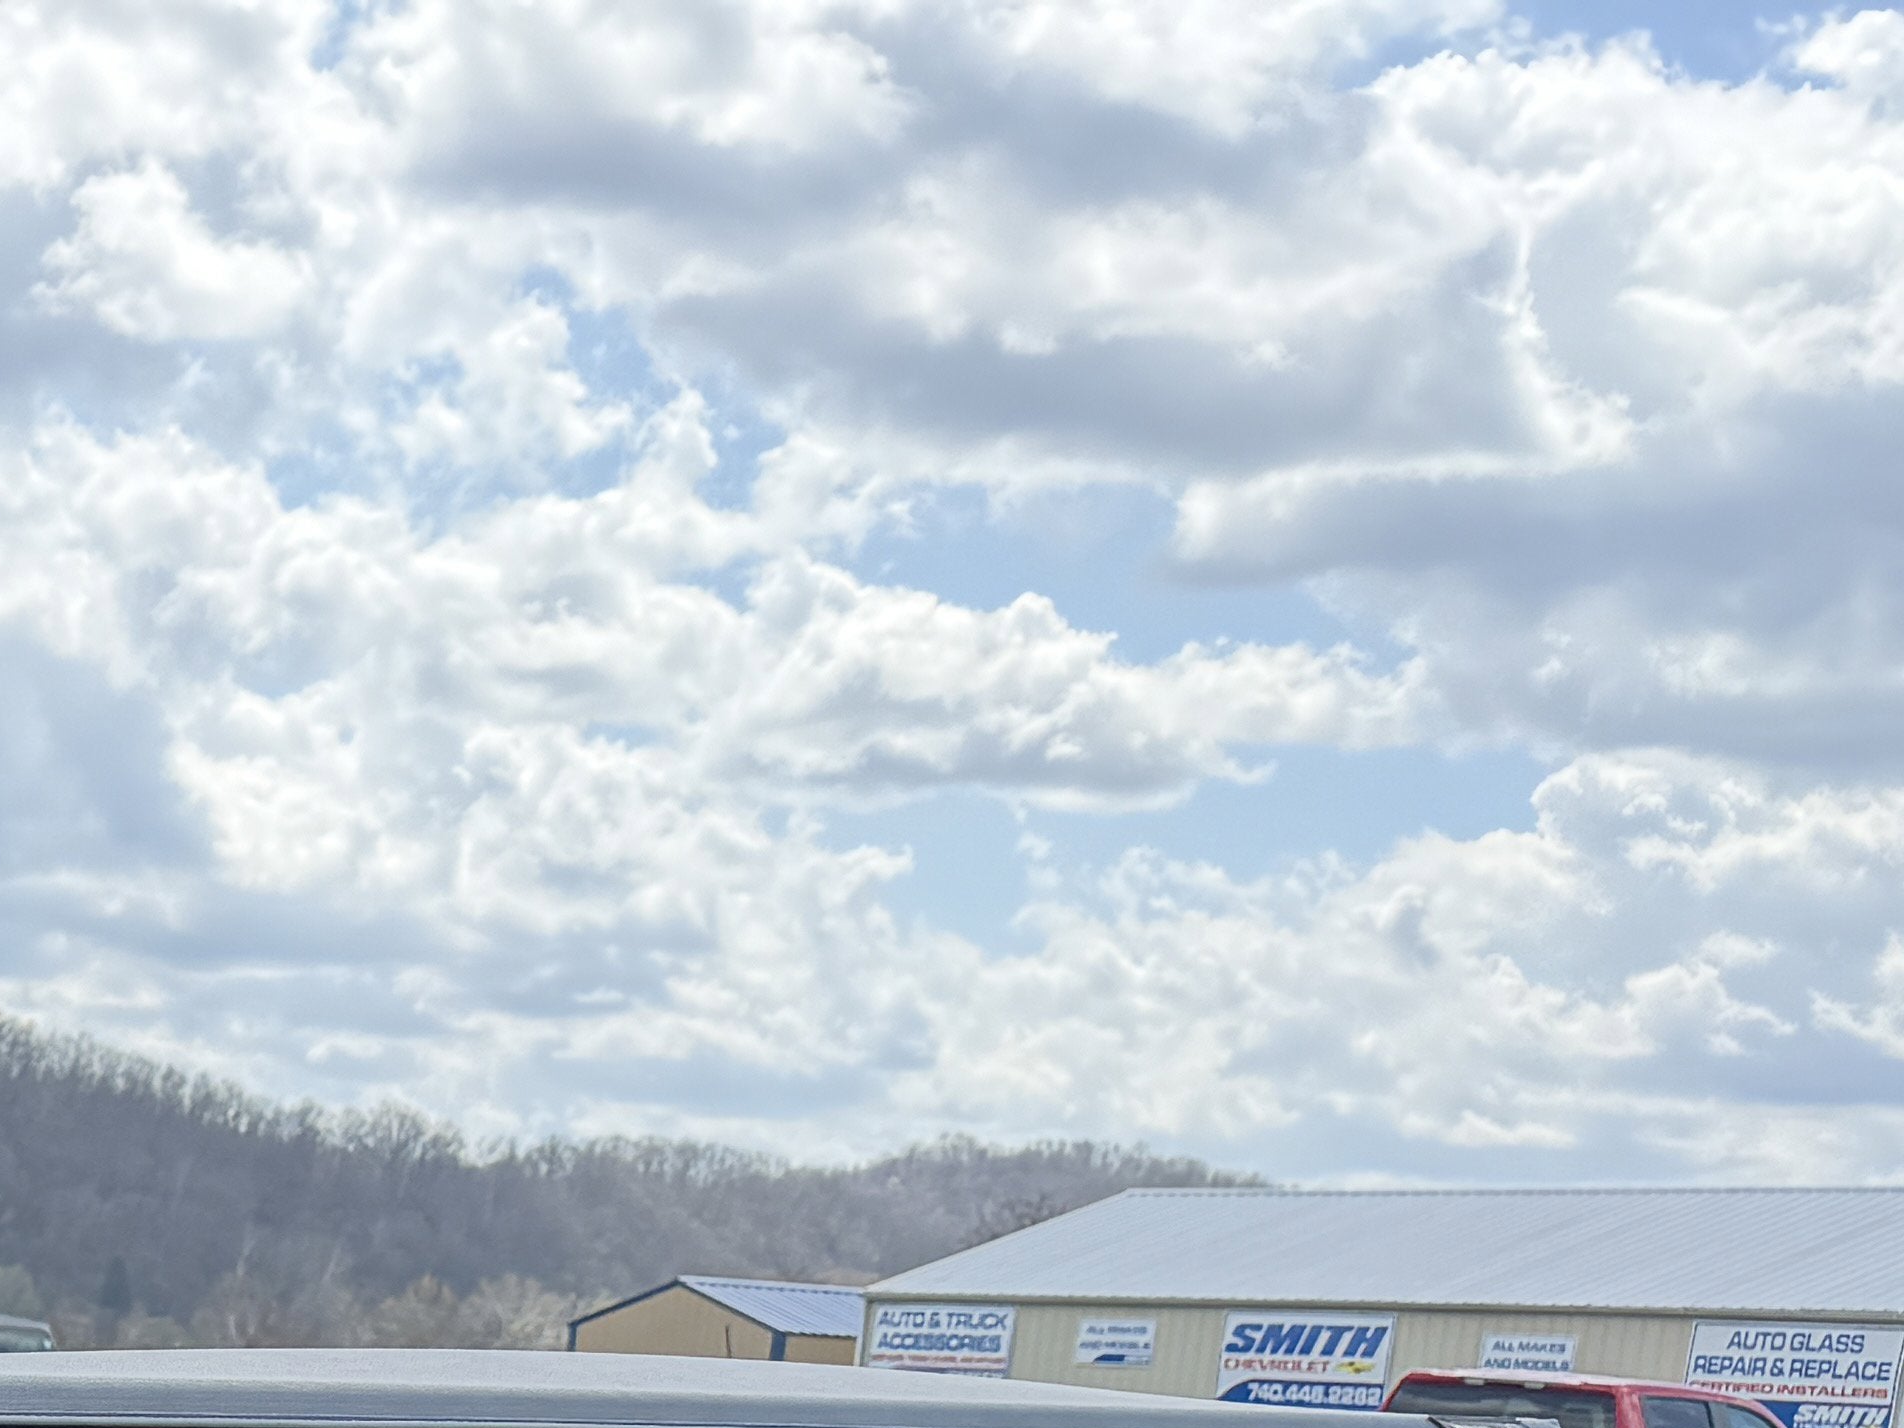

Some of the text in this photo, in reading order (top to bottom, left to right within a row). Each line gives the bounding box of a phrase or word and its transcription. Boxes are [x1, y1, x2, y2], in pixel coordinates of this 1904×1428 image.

[878, 1311, 925, 1328] AUTO
[946, 1312, 1008, 1330] TRUCK
[877, 1332, 1002, 1352] ACCESSORIES
[1224, 1323, 1389, 1358] SMITH
[1727, 1331, 1865, 1354] AUTO GLASS
[1224, 1358, 1330, 1373] CHEVROLET
[1693, 1355, 1892, 1381] REPAIR & REPLACE
[1777, 1383, 1888, 1399] INSTALLERS
[1794, 1404, 1889, 1426] SMITH
